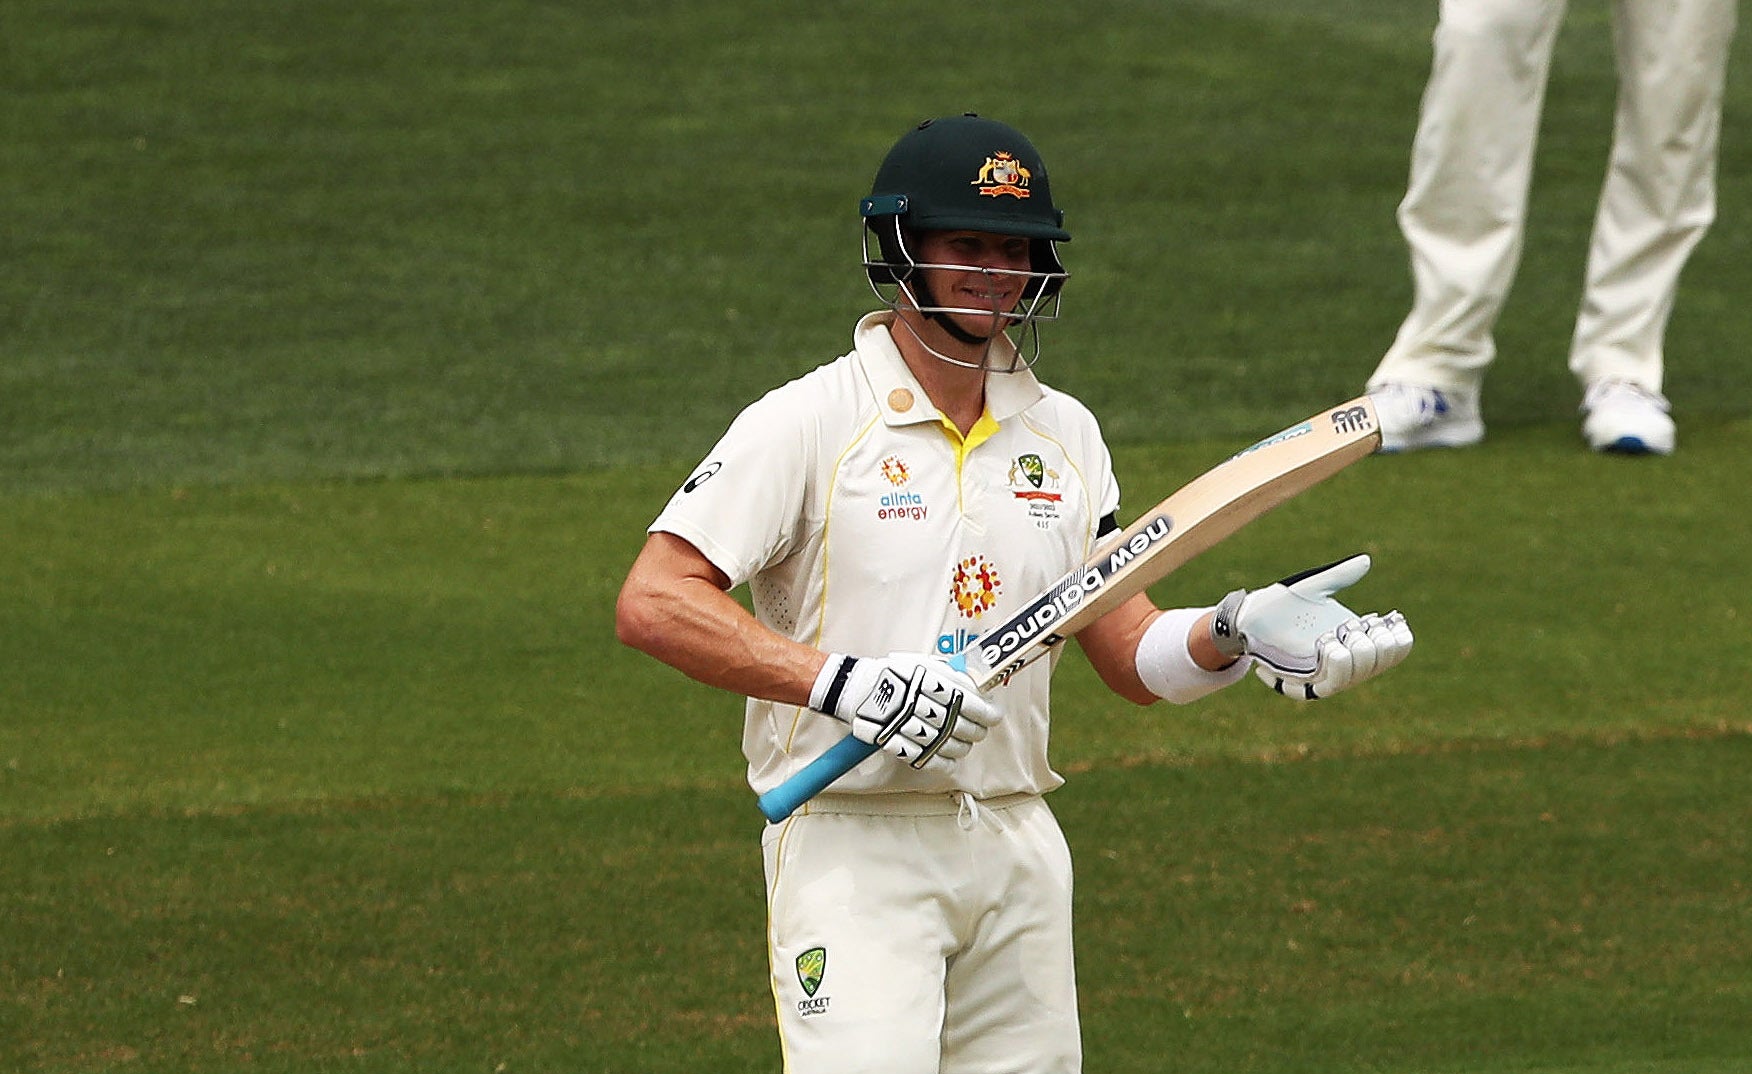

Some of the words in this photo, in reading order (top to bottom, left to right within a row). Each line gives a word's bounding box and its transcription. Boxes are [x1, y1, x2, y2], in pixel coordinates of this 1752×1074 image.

[878, 506, 928, 520] energy
[1109, 516, 1169, 574] new
[980, 565, 1105, 665] balance
[797, 997, 831, 1011] CRICKET
